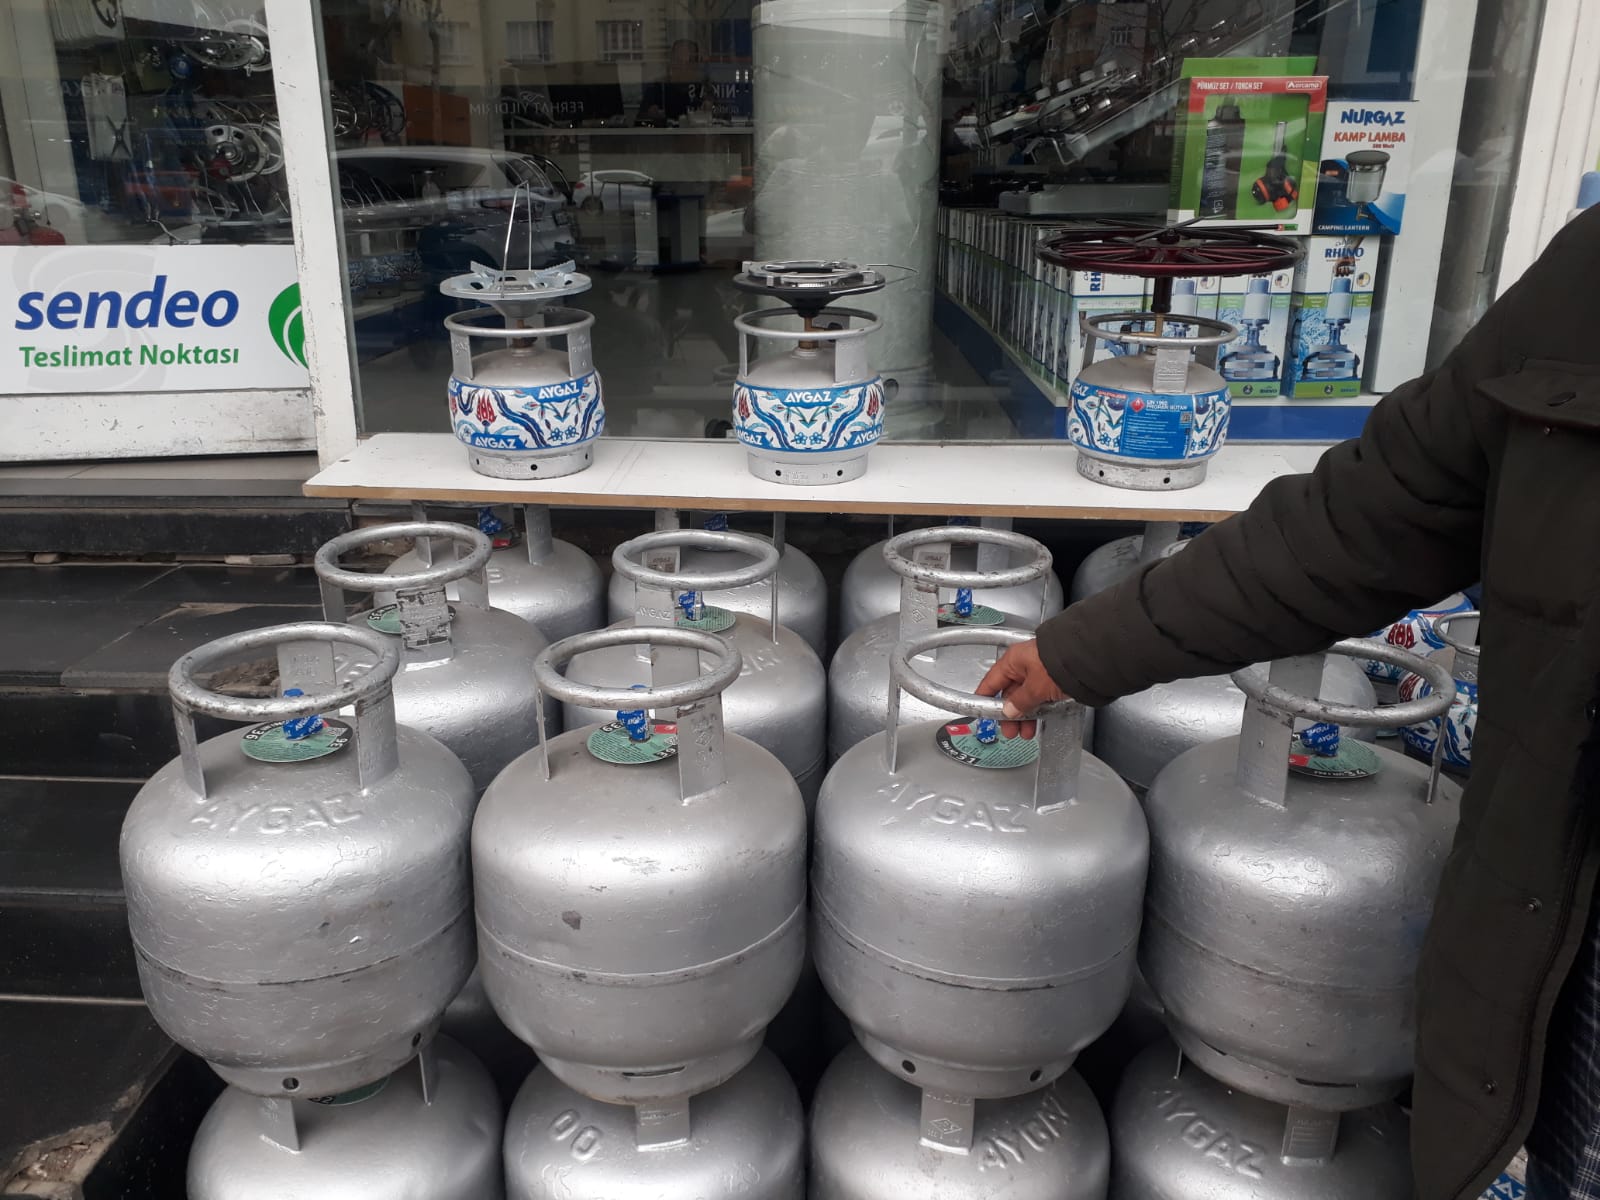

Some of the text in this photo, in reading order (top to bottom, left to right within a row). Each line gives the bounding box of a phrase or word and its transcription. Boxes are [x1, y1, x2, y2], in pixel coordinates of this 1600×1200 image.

[1252, 81, 1264, 90] SET
[1341, 109, 1406, 126] NURGAZ
[1334, 131, 1406, 142] KAMP LAMBA
[1325, 247, 1365, 258] RHINO
[15, 275, 239, 330] sendeo
[19, 343, 239, 367] Teslimat Noktası
[538, 382, 580, 399] AYGAZ
[785, 391, 832, 403] AYGAZ
[475, 436, 517, 449] AYGAZ
[853, 429, 881, 445] AYGAZ
[190, 794, 364, 836] AYGAZ
